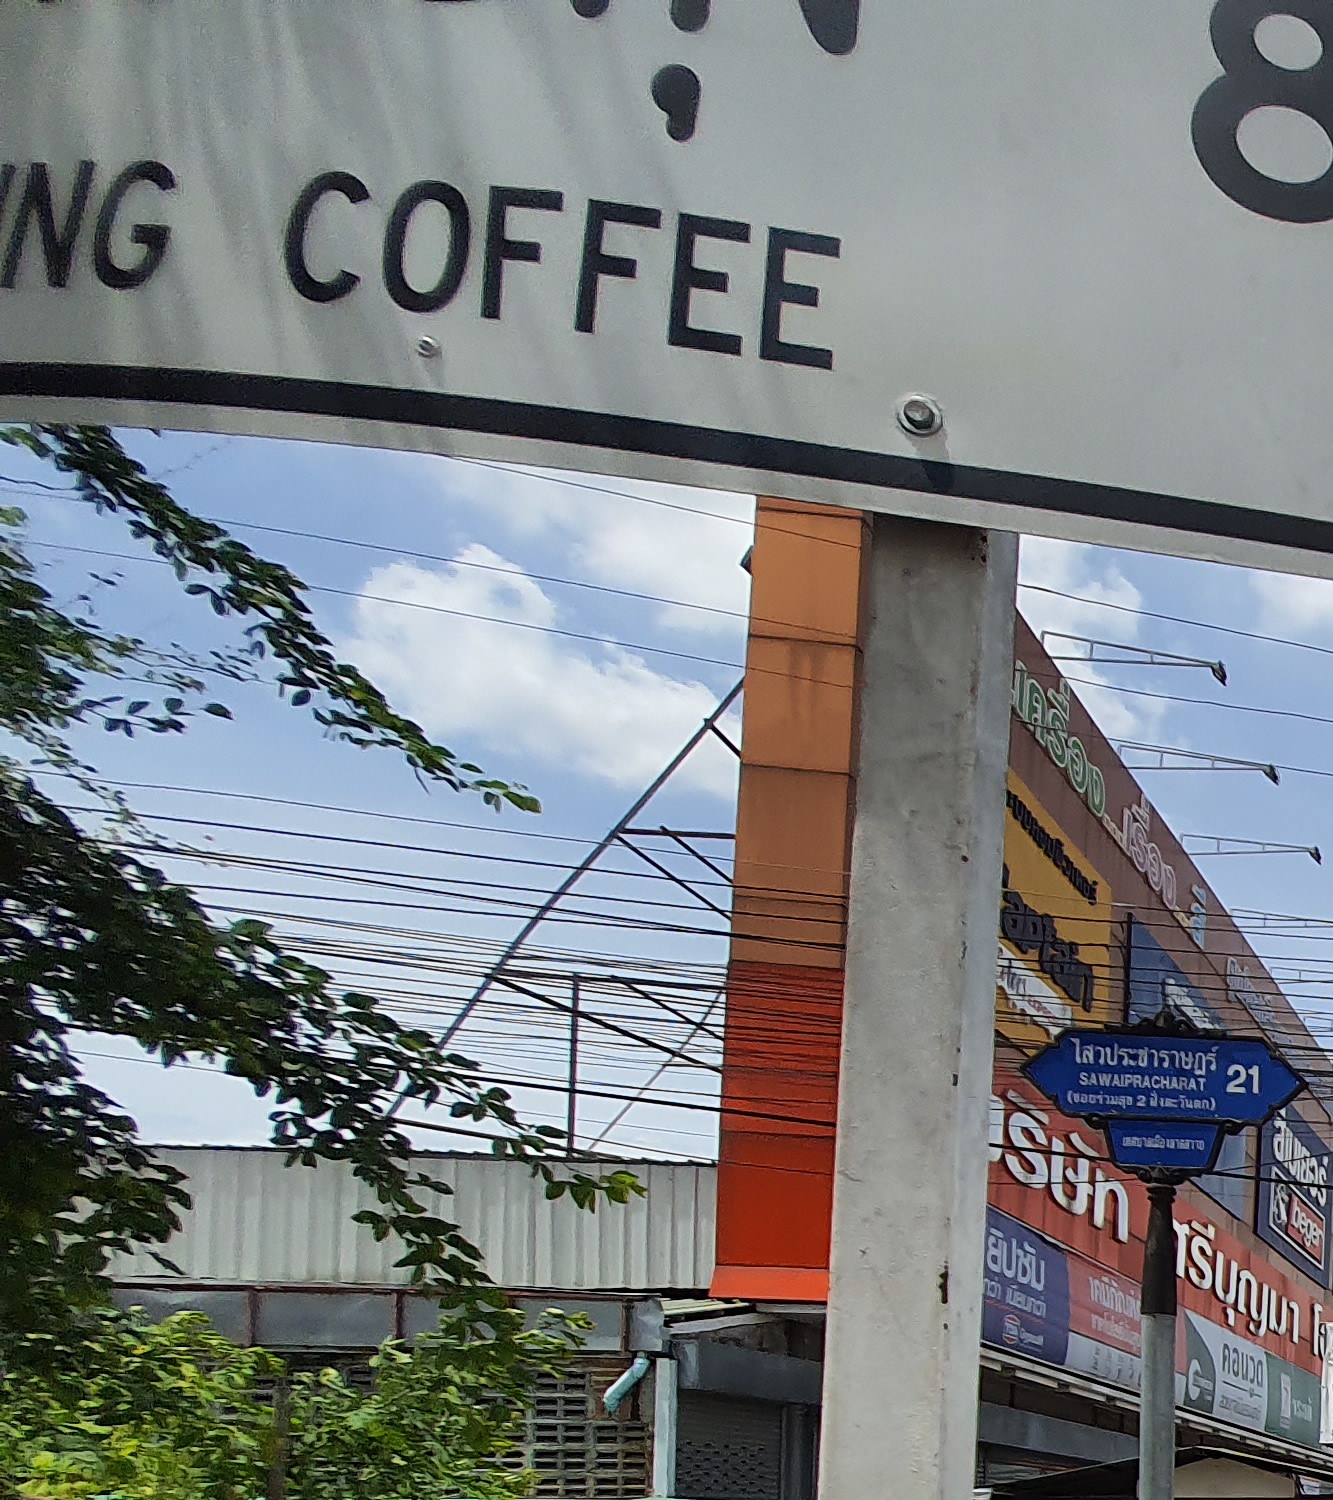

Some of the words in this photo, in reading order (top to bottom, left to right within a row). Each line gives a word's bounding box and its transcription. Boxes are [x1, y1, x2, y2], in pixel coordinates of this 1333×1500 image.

[0, 159, 176, 290] NG
[283, 170, 841, 370] COFFEE
[1079, 1073, 1206, 1091] SAWAIPRACHARAT
[1226, 1064, 1260, 1094] 21
[1137, 1095, 1146, 1107] 2
[1290, 1202, 1323, 1247] beger
